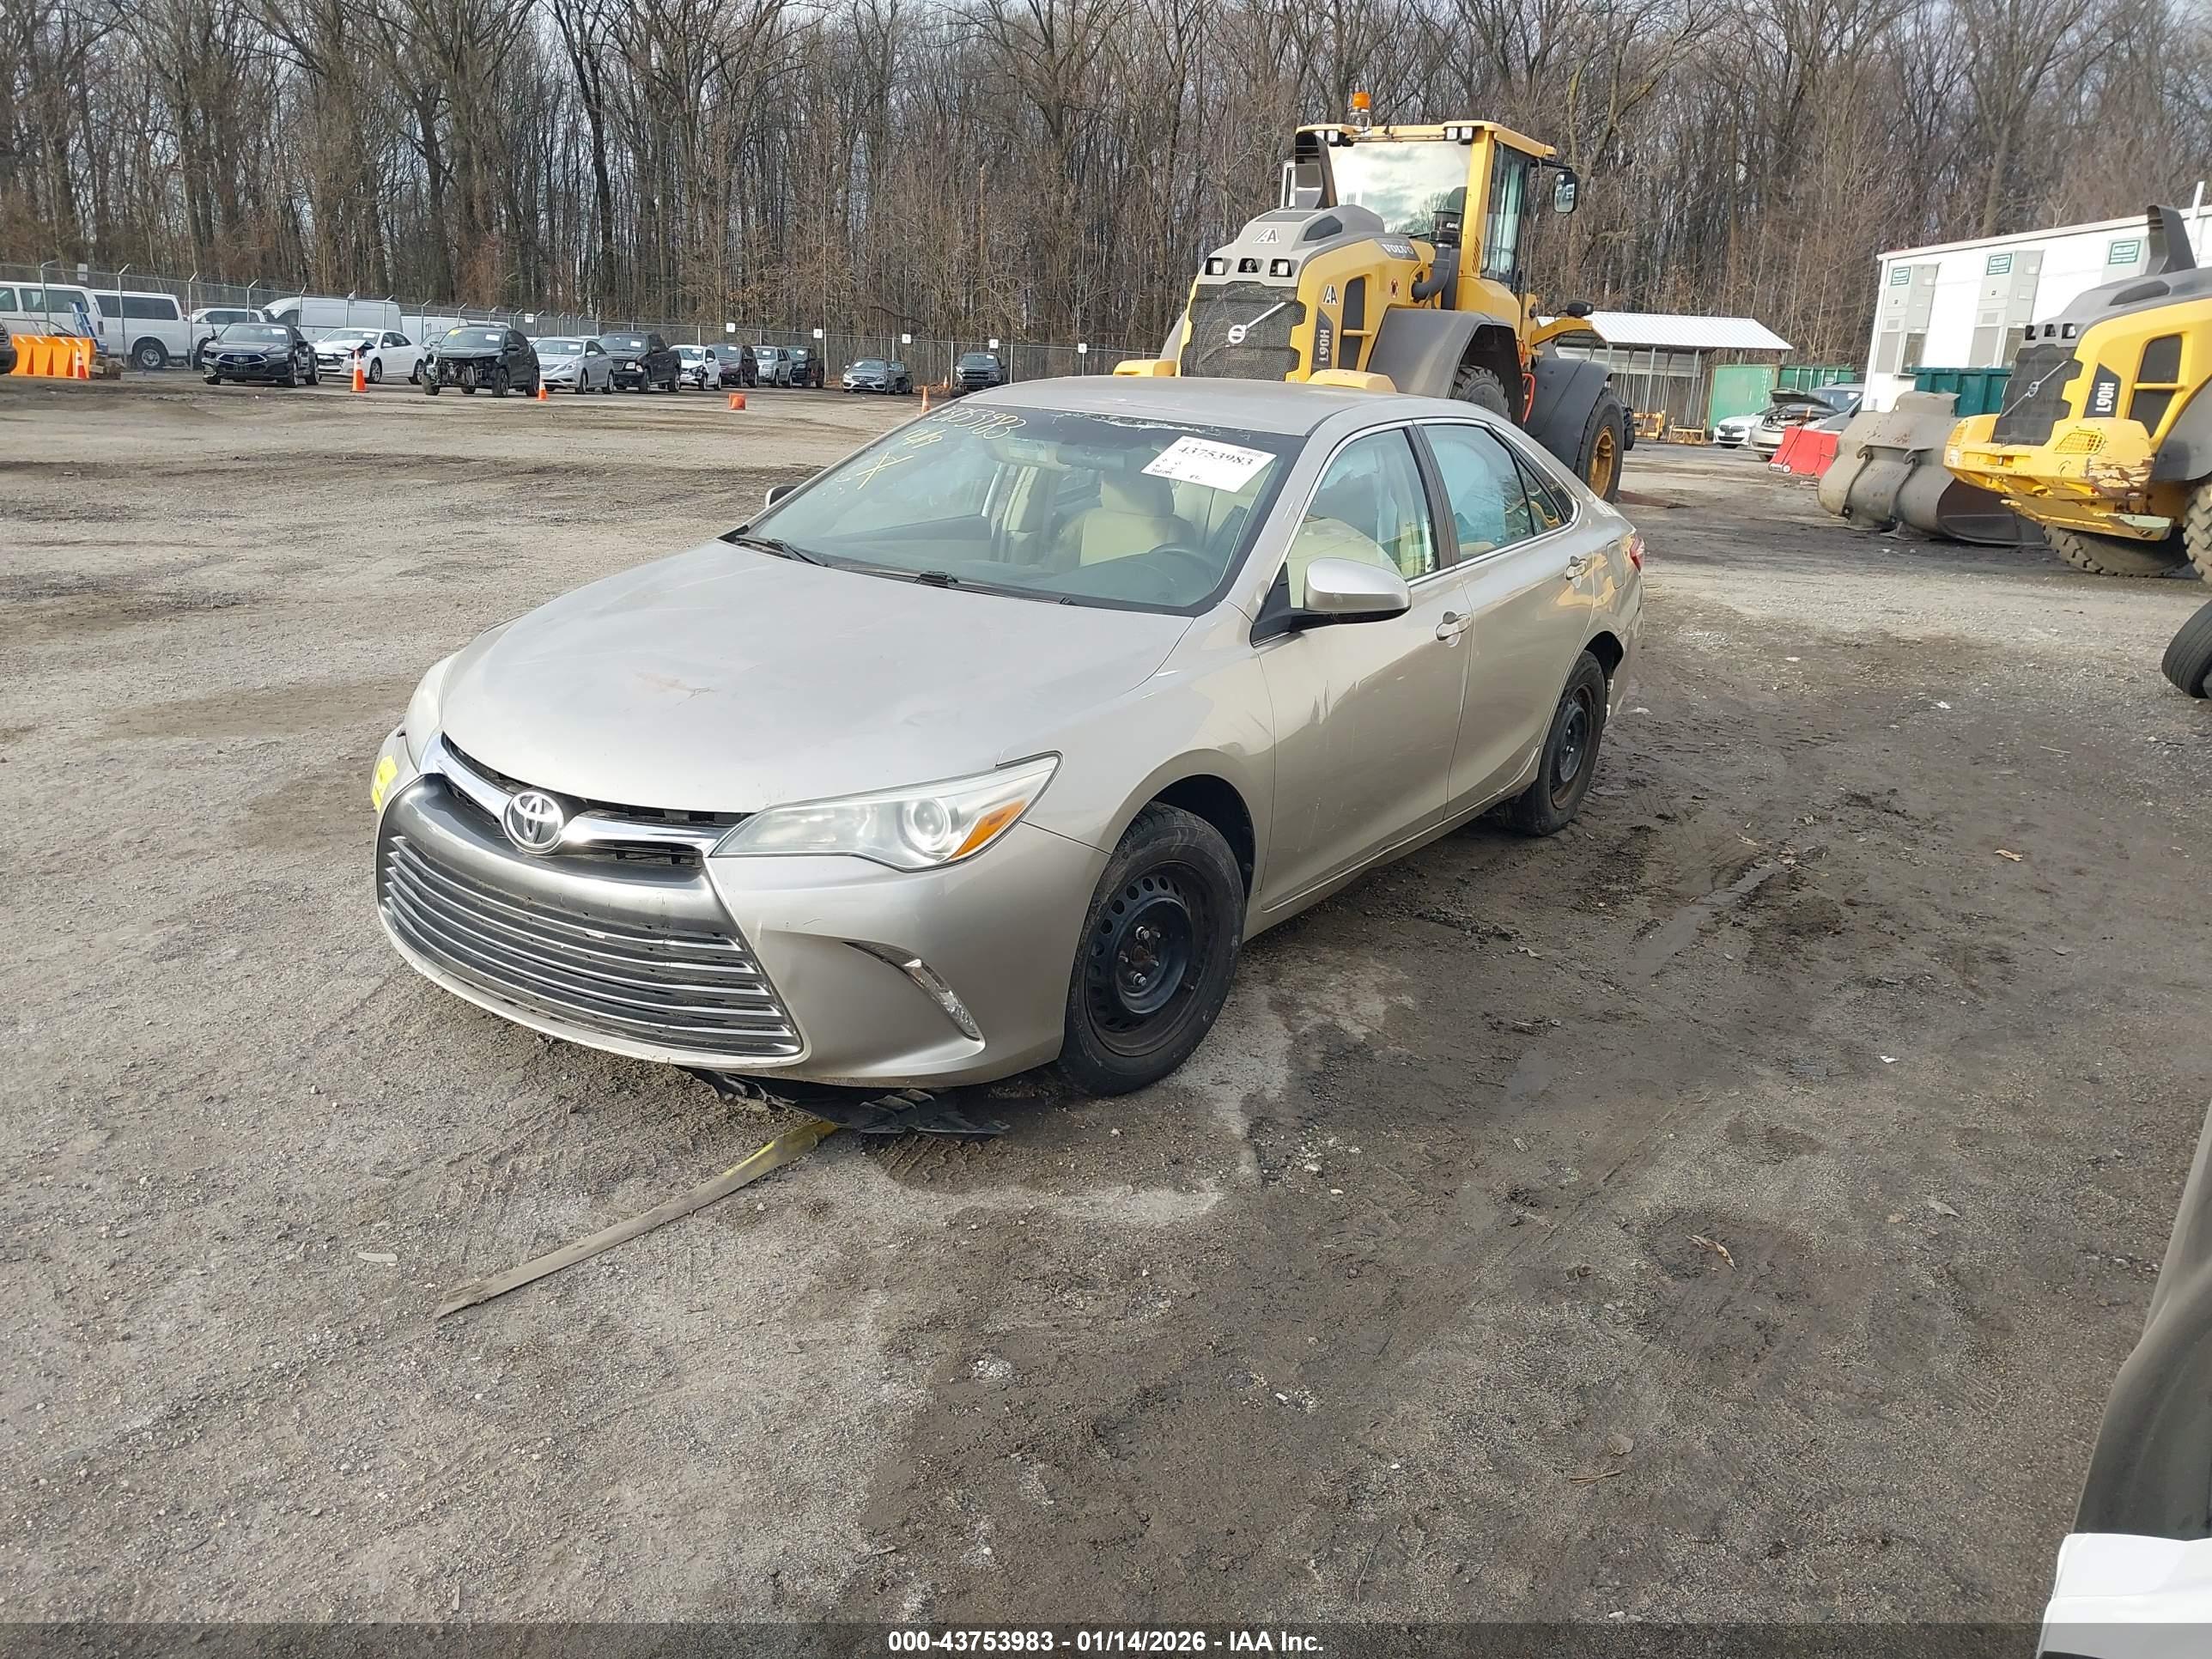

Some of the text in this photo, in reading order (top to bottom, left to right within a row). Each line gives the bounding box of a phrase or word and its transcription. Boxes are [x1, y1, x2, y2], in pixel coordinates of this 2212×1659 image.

[1382, 243, 1414, 255] VOLVO
[1318, 329, 1330, 362] L90H
[2095, 382, 2116, 412] L90H
[1178, 446, 1254, 466] 43753983
